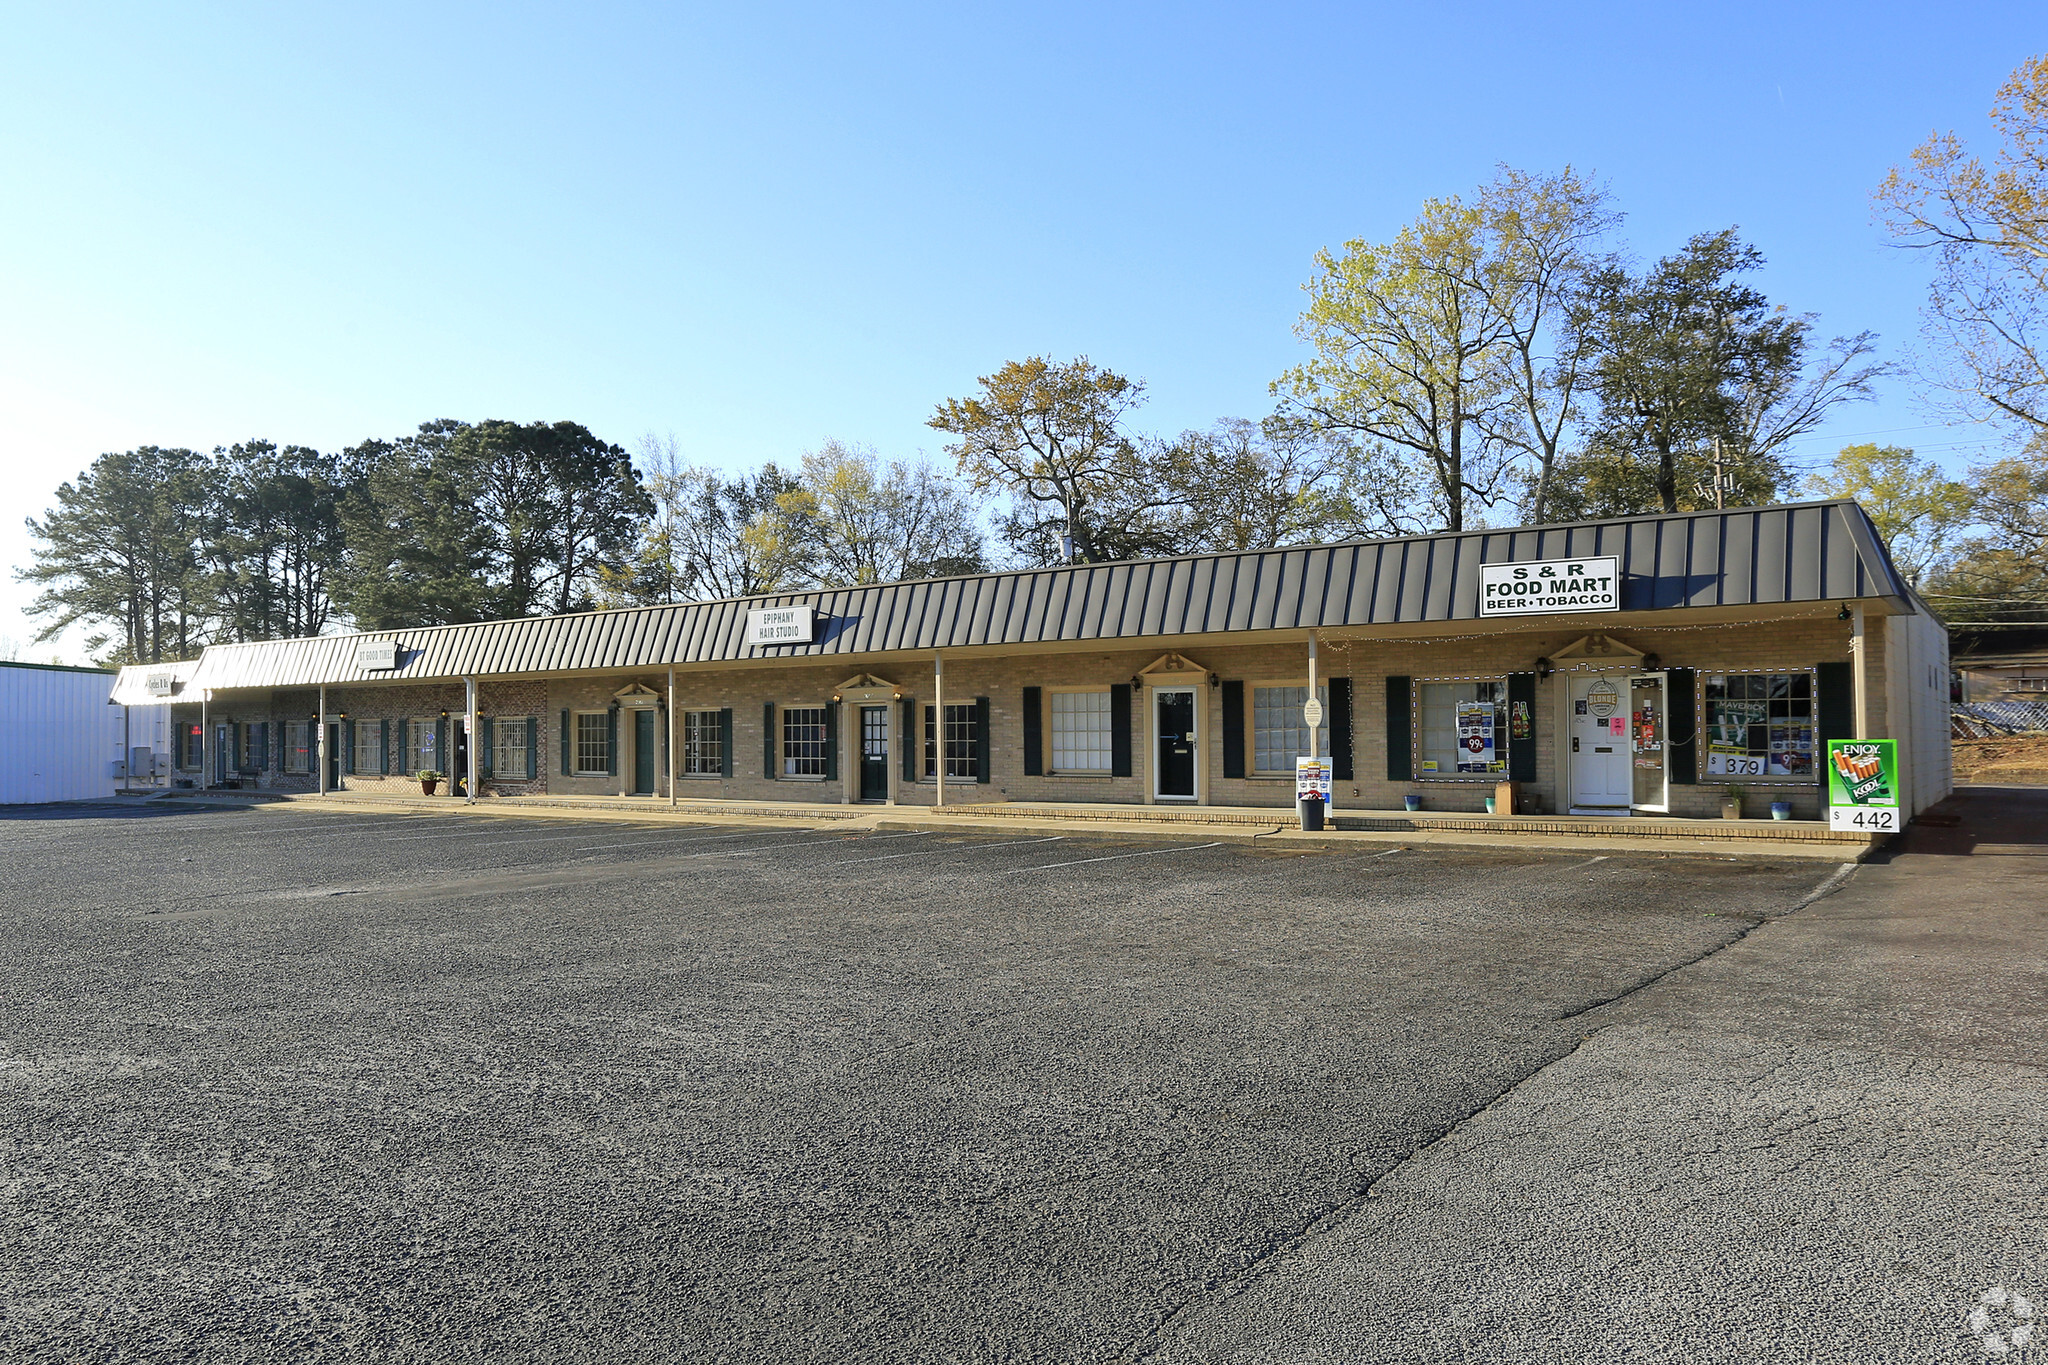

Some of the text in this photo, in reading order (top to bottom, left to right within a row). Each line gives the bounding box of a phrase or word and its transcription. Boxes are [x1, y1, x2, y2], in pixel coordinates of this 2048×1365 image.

[1513, 564, 1585, 579] S & R
[1486, 577, 1611, 597] FOOD MART
[1487, 594, 1612, 610] BEER TOBACCO
[764, 612, 794, 624] EPIPHANY
[760, 626, 798, 638] HAIR STUDIO
[366, 650, 378, 661] GOOD
[379, 649, 393, 660] TIMES
[1588, 694, 1616, 704] BLONDE
[1719, 700, 1766, 711] MAVERICK
[1711, 756, 1717, 765] $
[1853, 779, 1881, 798] KOOL
[1833, 810, 1893, 829] $ 4.42
